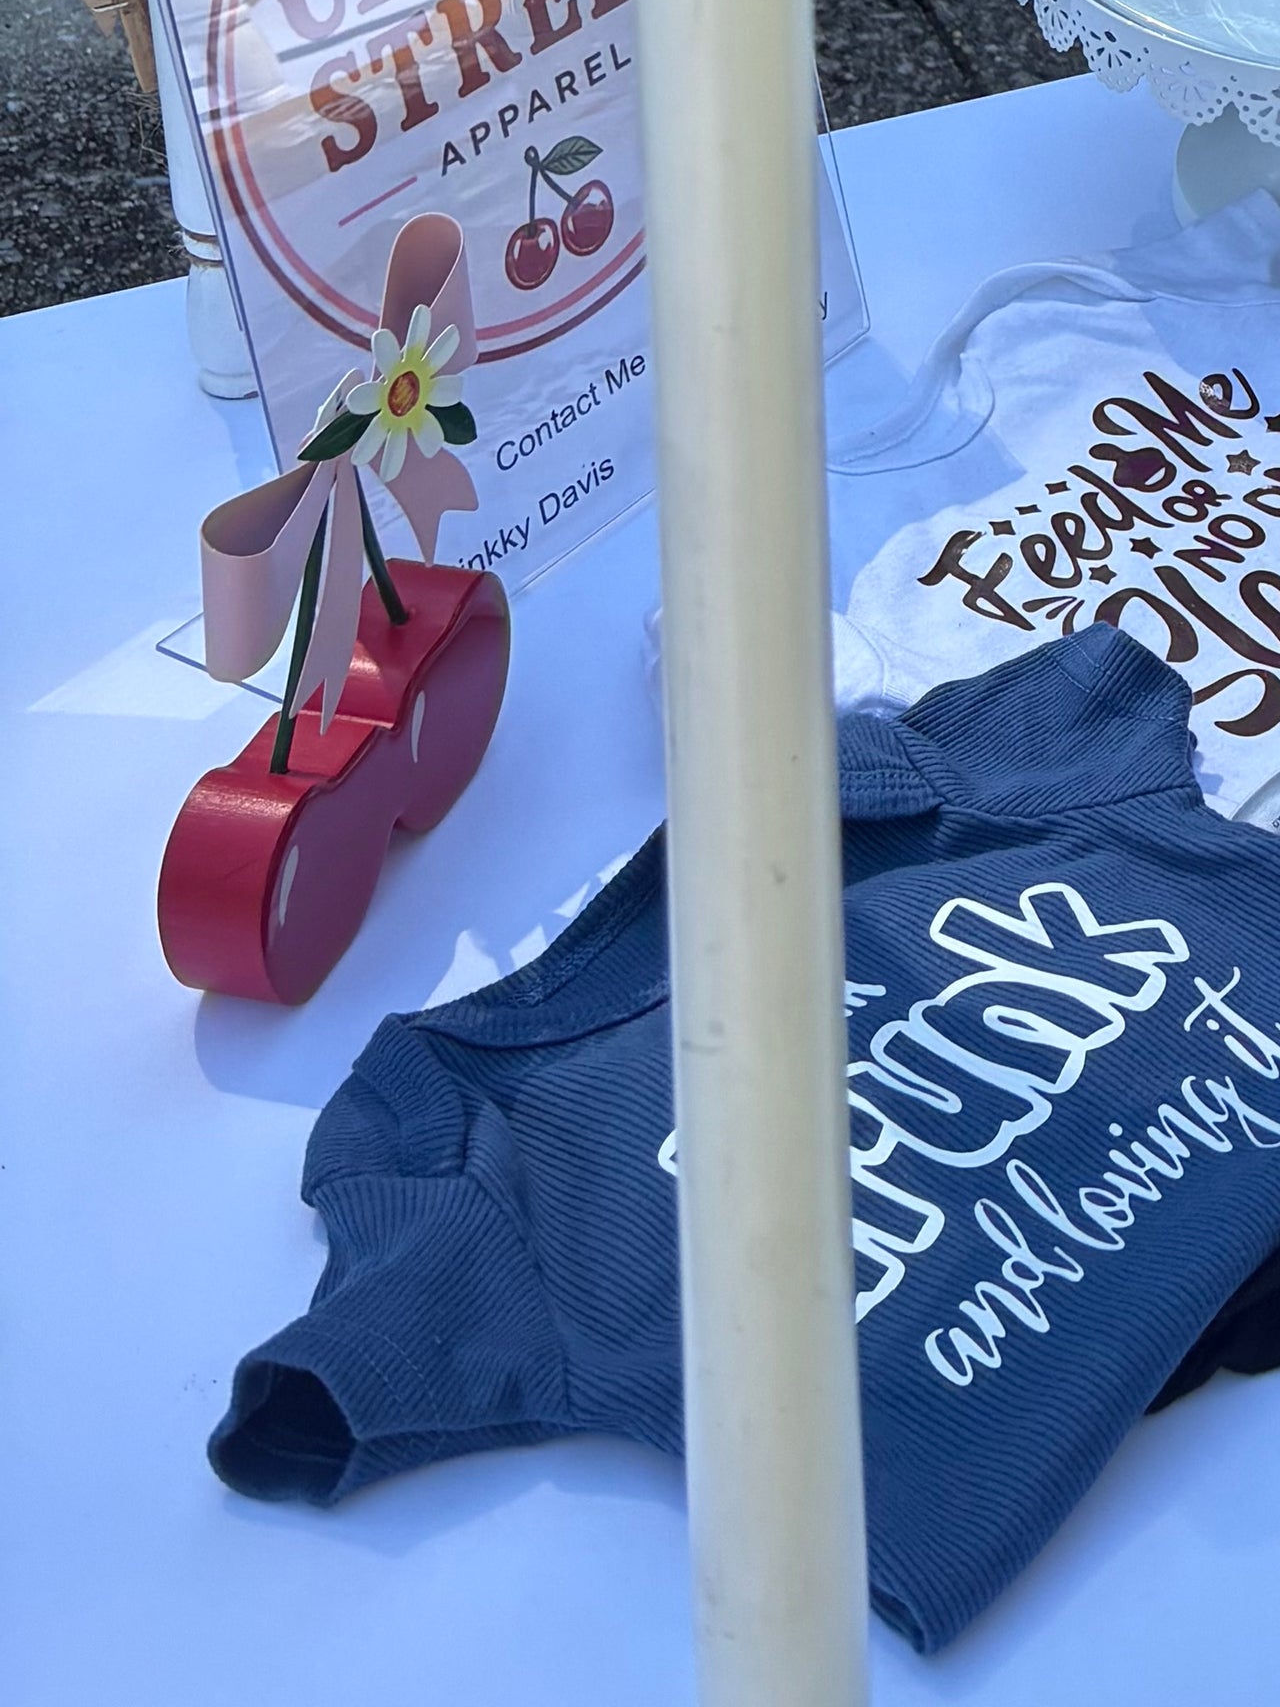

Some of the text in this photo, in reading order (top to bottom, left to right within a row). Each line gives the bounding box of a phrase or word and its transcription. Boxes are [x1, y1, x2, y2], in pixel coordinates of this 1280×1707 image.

[440, 42, 632, 177] APPAREL
[496, 354, 647, 472] Contact Me
[1091, 367, 1261, 473] Me
[538, 457, 615, 525] Davis
[1161, 479, 1233, 523] OR
[1172, 513, 1267, 583] NO
[924, 1197, 1085, 1387] and
